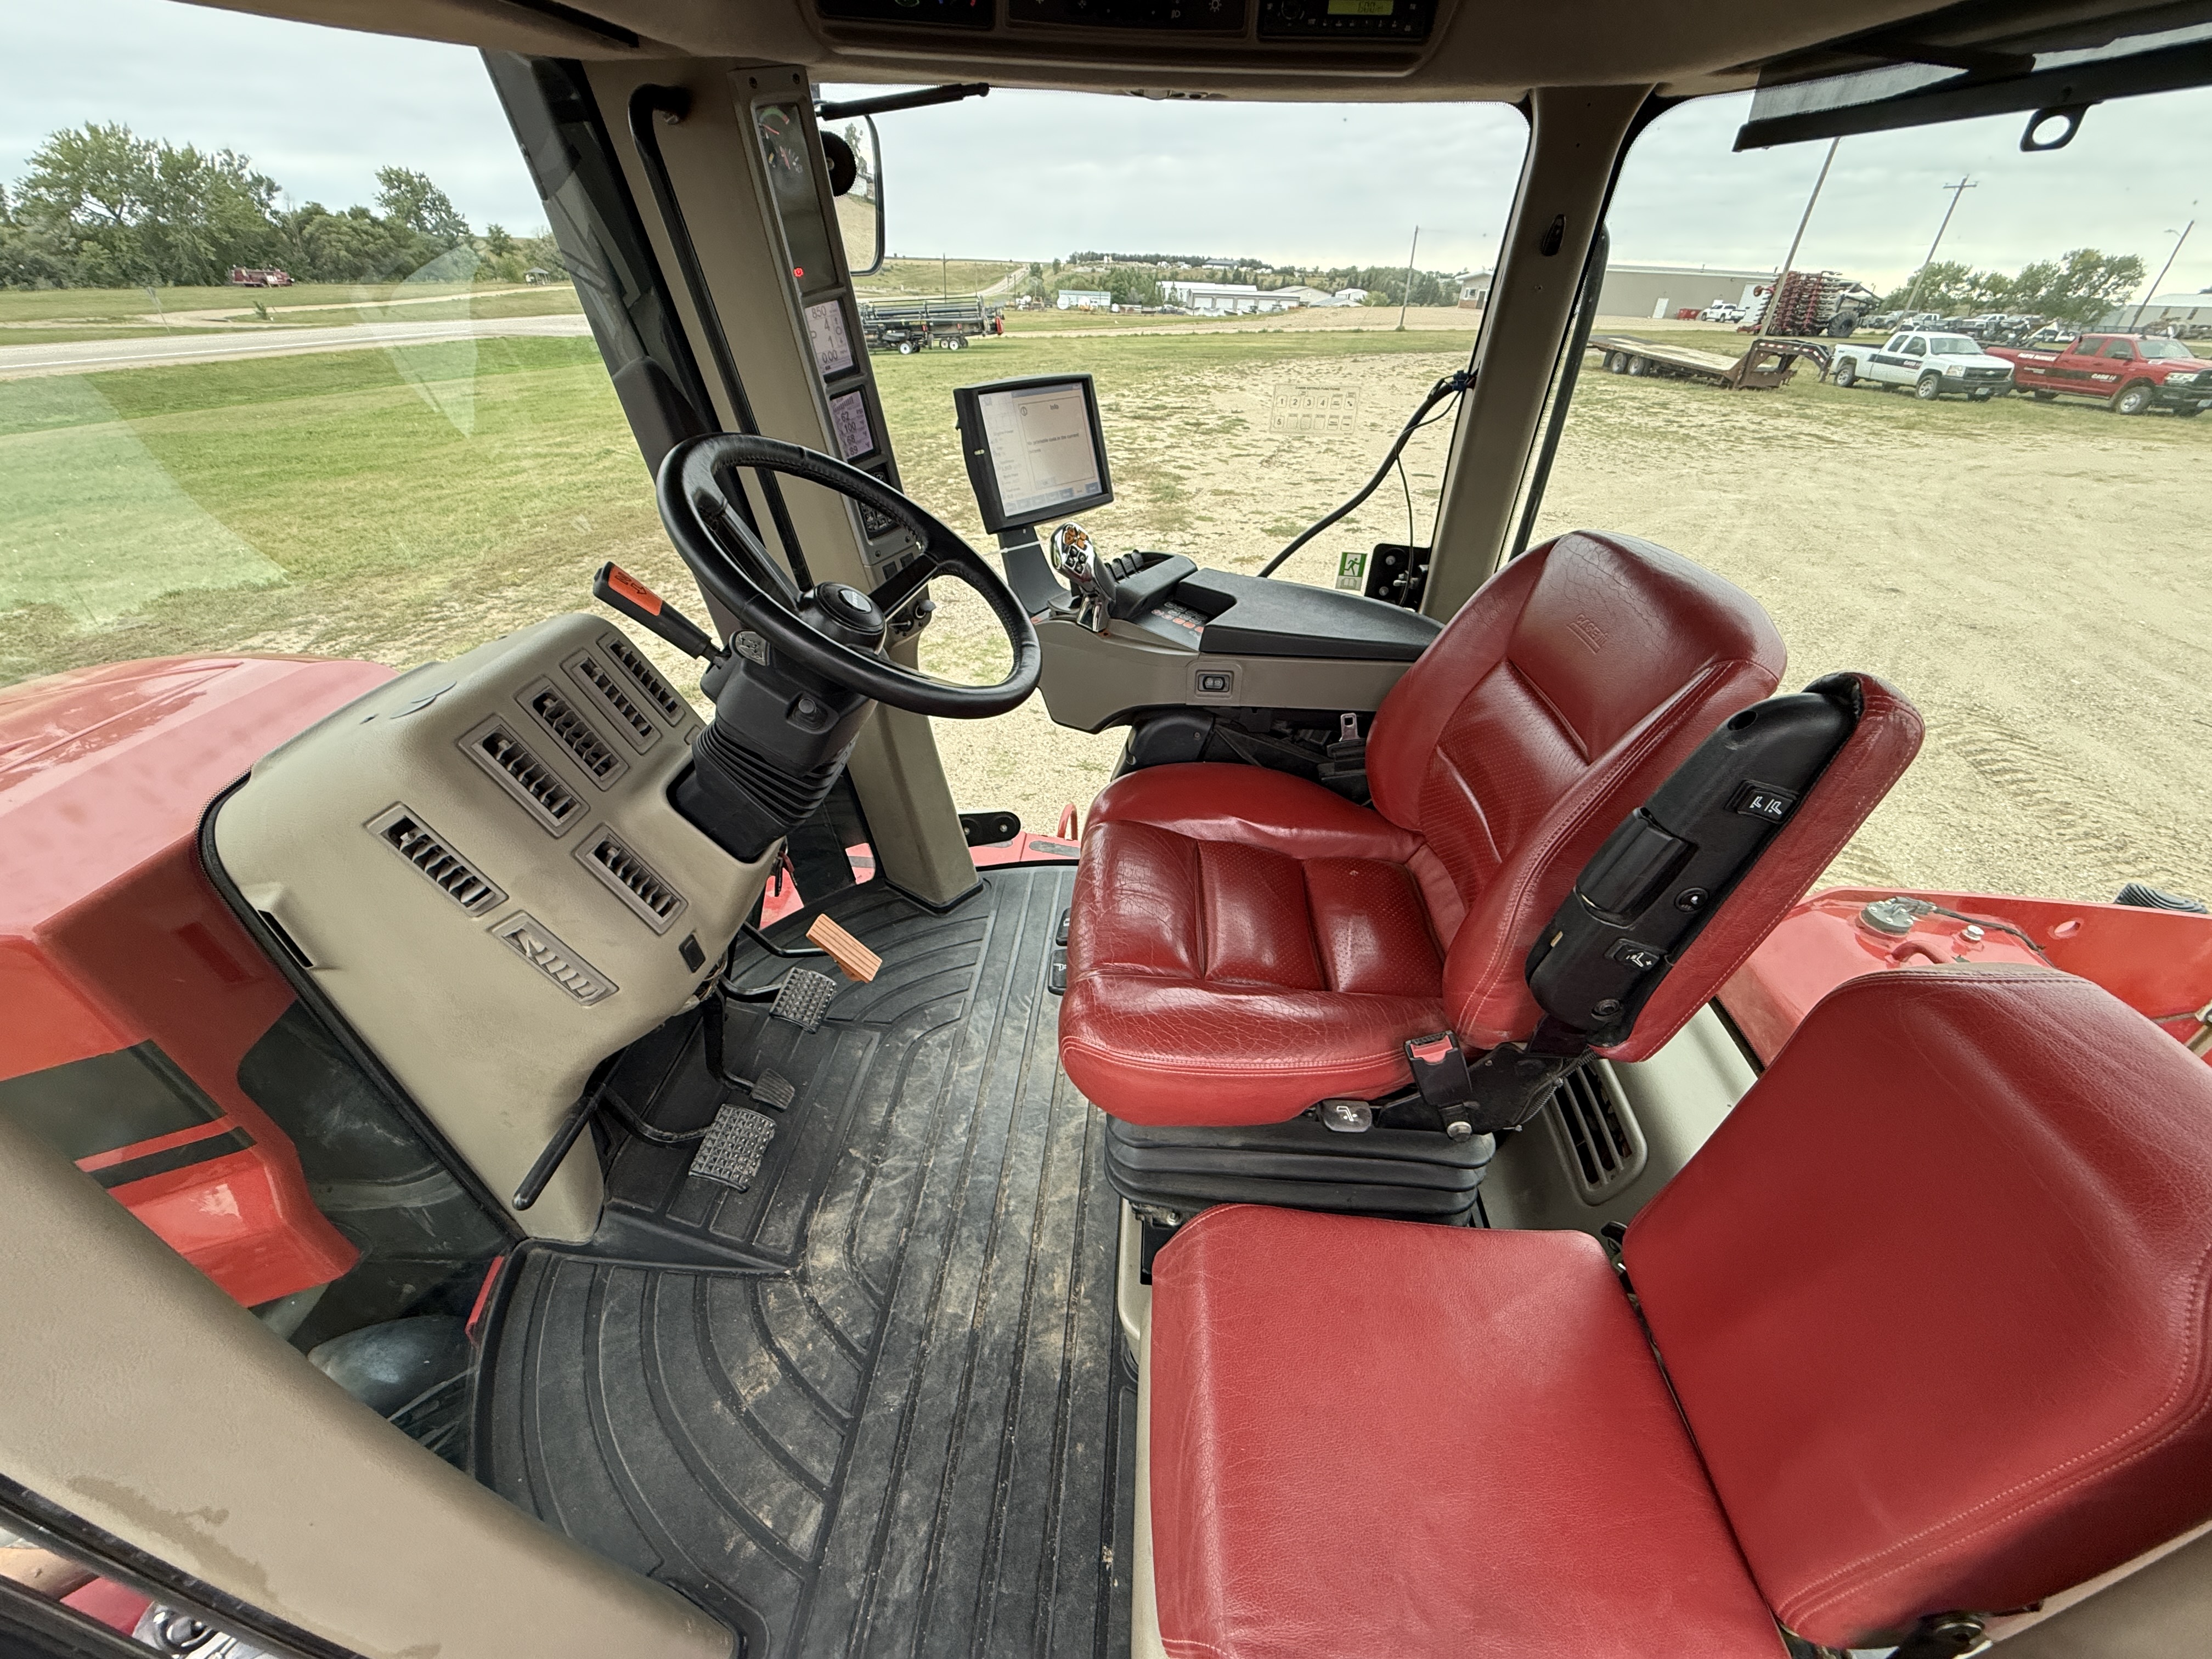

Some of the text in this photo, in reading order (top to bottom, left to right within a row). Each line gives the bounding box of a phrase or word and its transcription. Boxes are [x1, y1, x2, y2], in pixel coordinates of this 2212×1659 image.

[811, 306, 827, 318] 850
[825, 318, 830, 331] 4
[828, 335, 834, 348] 1
[822, 349, 838, 364] 0.00
[841, 411, 849, 423] 62
[845, 421, 856, 433] 100
[847, 434, 856, 445] 68
